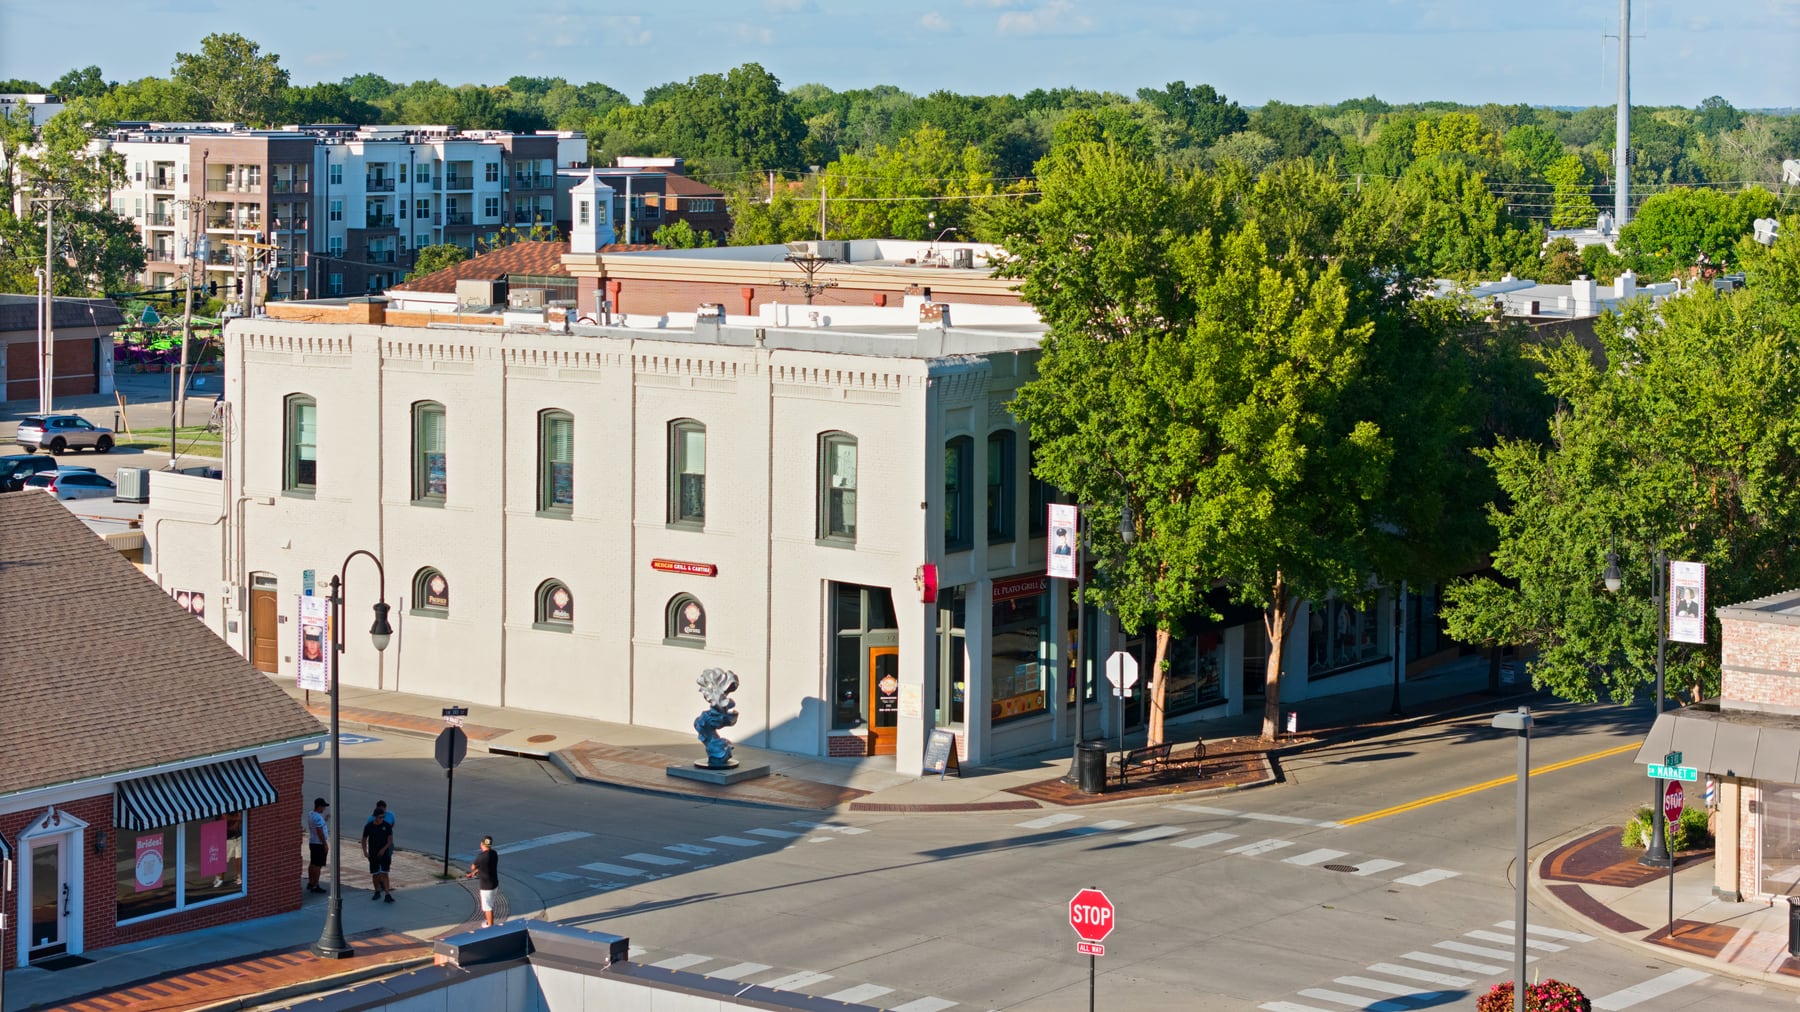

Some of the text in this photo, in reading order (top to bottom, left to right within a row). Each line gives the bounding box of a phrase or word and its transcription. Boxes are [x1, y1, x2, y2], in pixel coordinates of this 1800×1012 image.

[993, 579, 1047, 596] EL PLATO GRILL &
[1657, 765, 1687, 779] MARKET
[1665, 792, 1682, 810] STOP
[137, 838, 162, 849] Brides!
[1073, 904, 1110, 926] STOP
[1091, 946, 1103, 954] WAY
